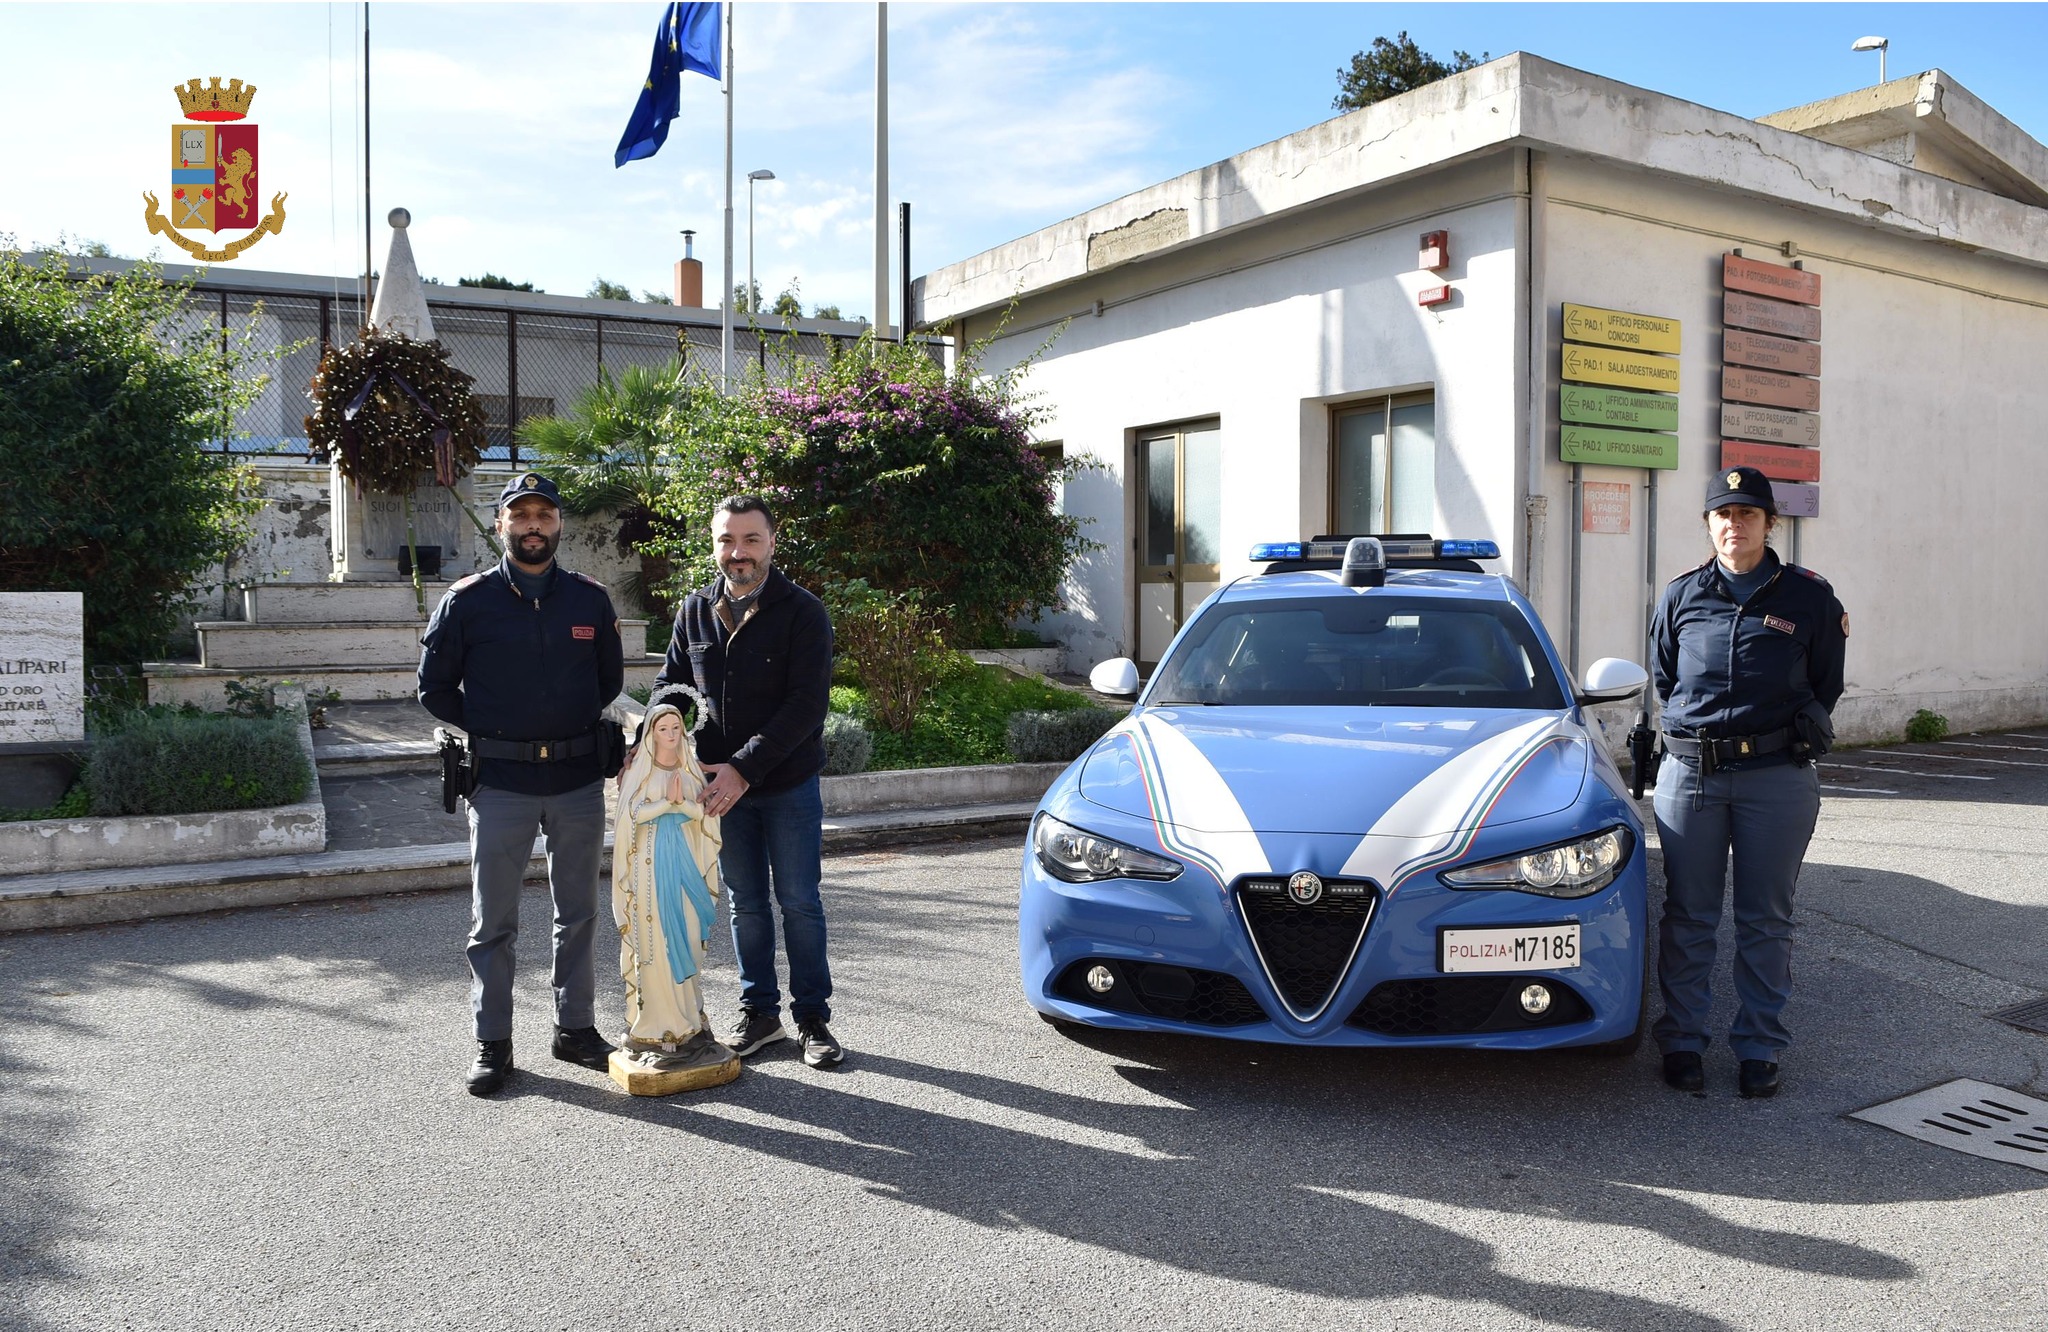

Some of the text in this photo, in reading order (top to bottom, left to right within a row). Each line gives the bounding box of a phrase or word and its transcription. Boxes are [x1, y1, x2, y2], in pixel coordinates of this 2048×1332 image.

[1607, 314, 1670, 334] UFFICIO PERSONALE
[1607, 330, 1640, 345] CONCORSI
[1607, 361, 1625, 374] SALA
[1625, 364, 1678, 381] ADDESTRAMENTO
[1605, 394, 1678, 412] UFFICIO AMMINISTRATIVO
[1605, 409, 1639, 422] CONTABILE
[1744, 410, 1798, 426] UFFICIO PASSAPORTI
[1744, 425, 1766, 436] LICENZE
[1606, 442, 1631, 454] UFFICIO
[1631, 443, 1663, 457] SANITARIO
[371, 501, 451, 513] SUOI CADUTI
[1767, 617, 1793, 632] POLIZIA
[1449, 934, 1576, 962] POLIZIA M7185
